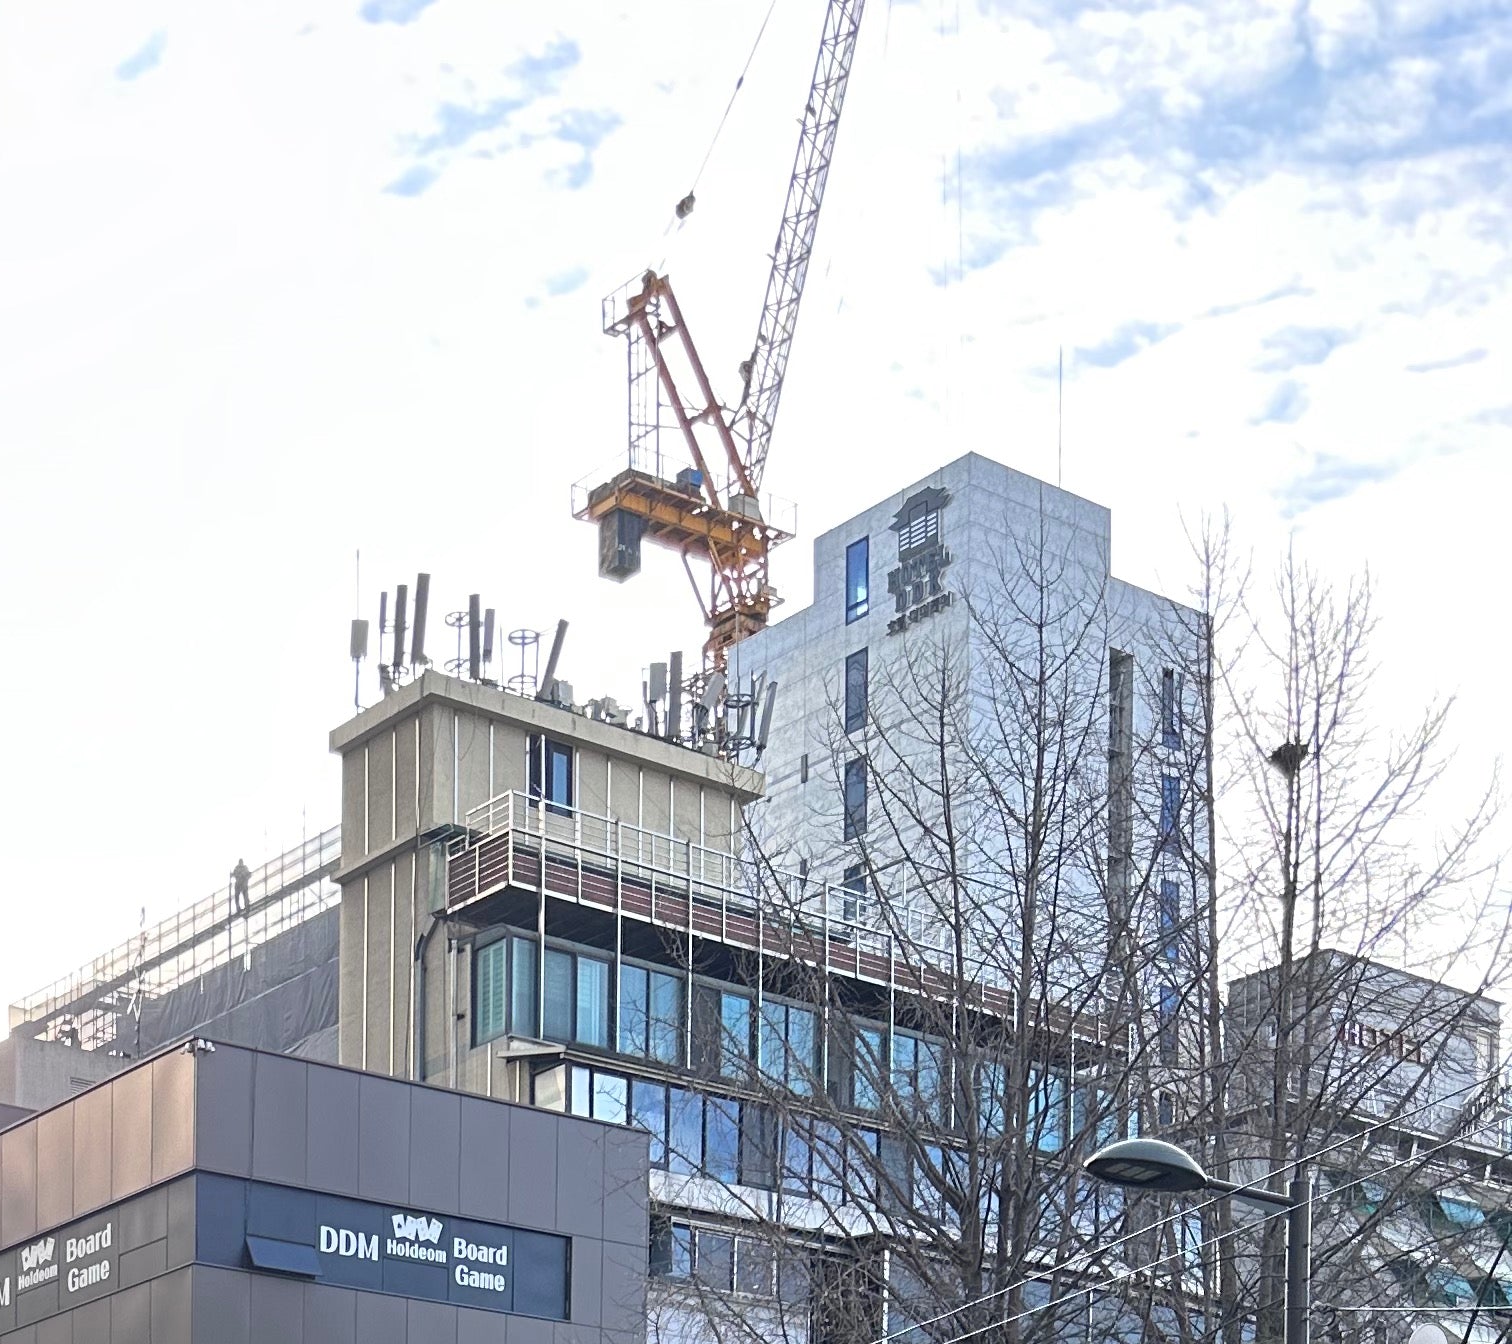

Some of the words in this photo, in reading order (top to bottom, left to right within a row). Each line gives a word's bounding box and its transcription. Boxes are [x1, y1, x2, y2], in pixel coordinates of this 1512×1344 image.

[17, 1264, 58, 1291] Holdeom
[66, 1223, 112, 1263] Board
[319, 1225, 379, 1261] DDM
[386, 1238, 448, 1264] Holdeom
[453, 1237, 508, 1266] Board
[67, 1259, 110, 1293] Game
[454, 1264, 505, 1292] Game
